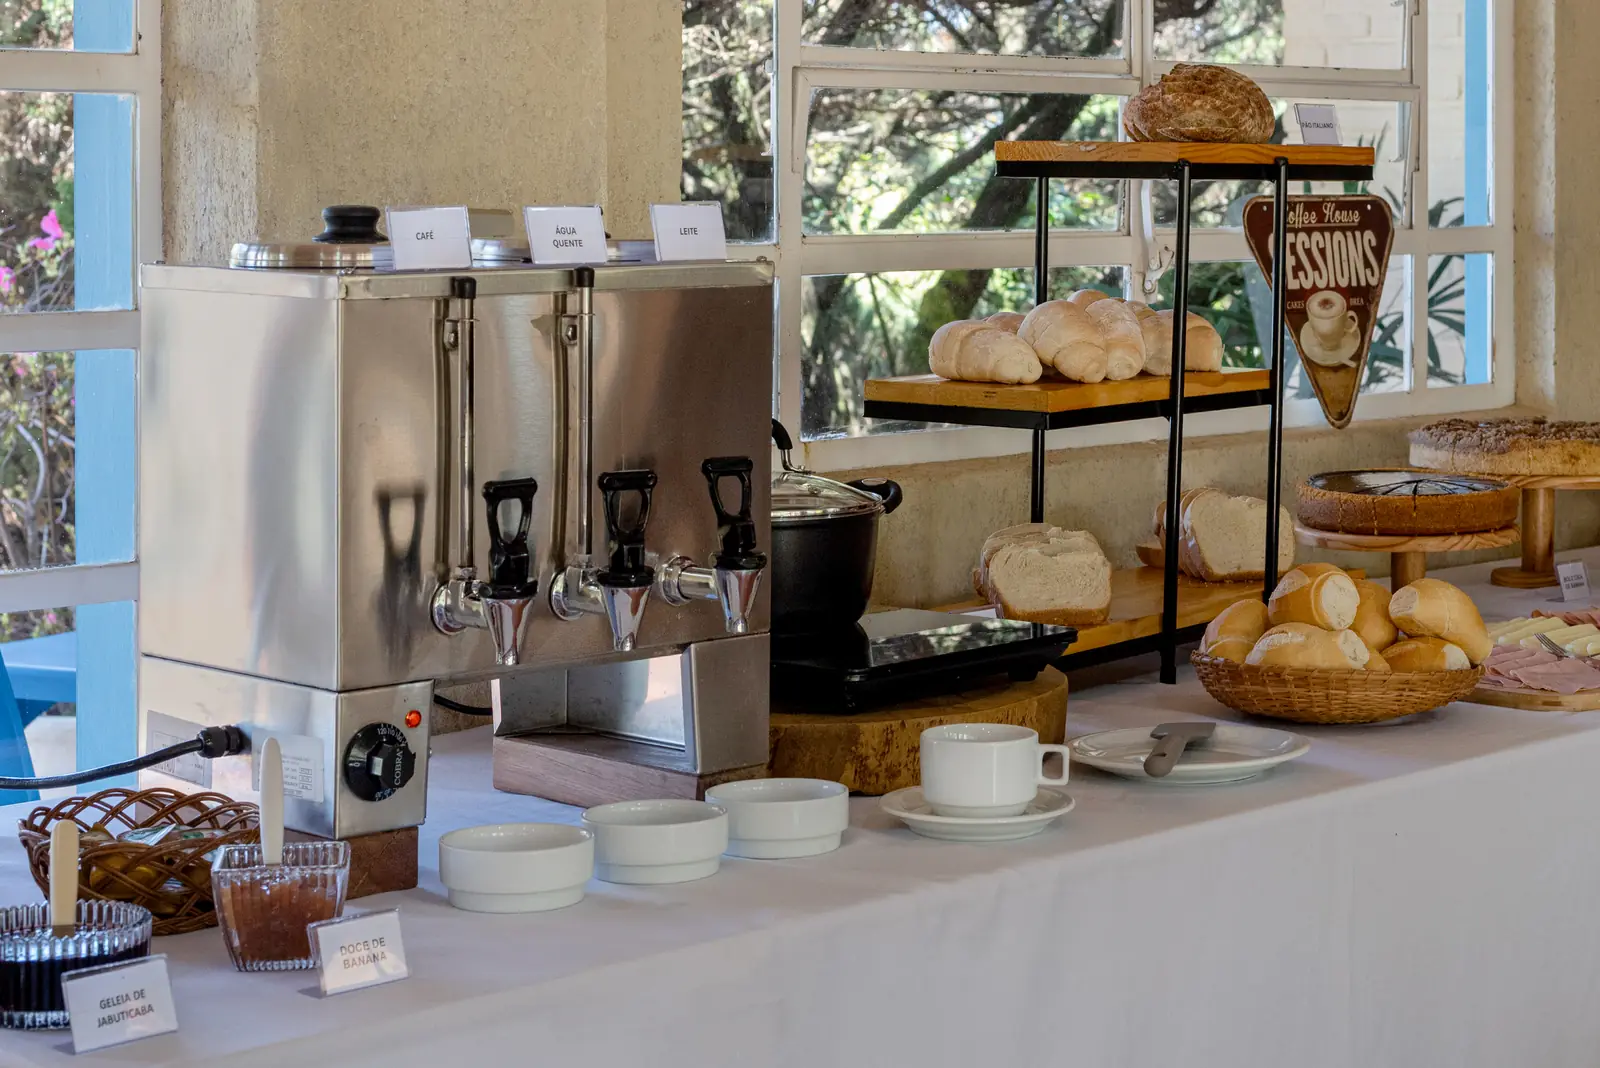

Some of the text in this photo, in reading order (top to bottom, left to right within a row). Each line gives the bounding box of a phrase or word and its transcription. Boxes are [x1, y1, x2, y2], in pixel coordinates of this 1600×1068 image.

[1287, 202, 1360, 228] offee House
[415, 230, 434, 241] CAFÉ
[555, 225, 577, 236] ÁGUA
[680, 227, 698, 236] LEITE
[552, 238, 583, 249] QUENTE
[1286, 300, 1305, 310] CAKES
[340, 937, 386, 957] DOCE DE
[343, 951, 388, 971] BANANA
[99, 988, 146, 1010] GELEIA DE
[97, 1003, 155, 1029] JABUTICABA
